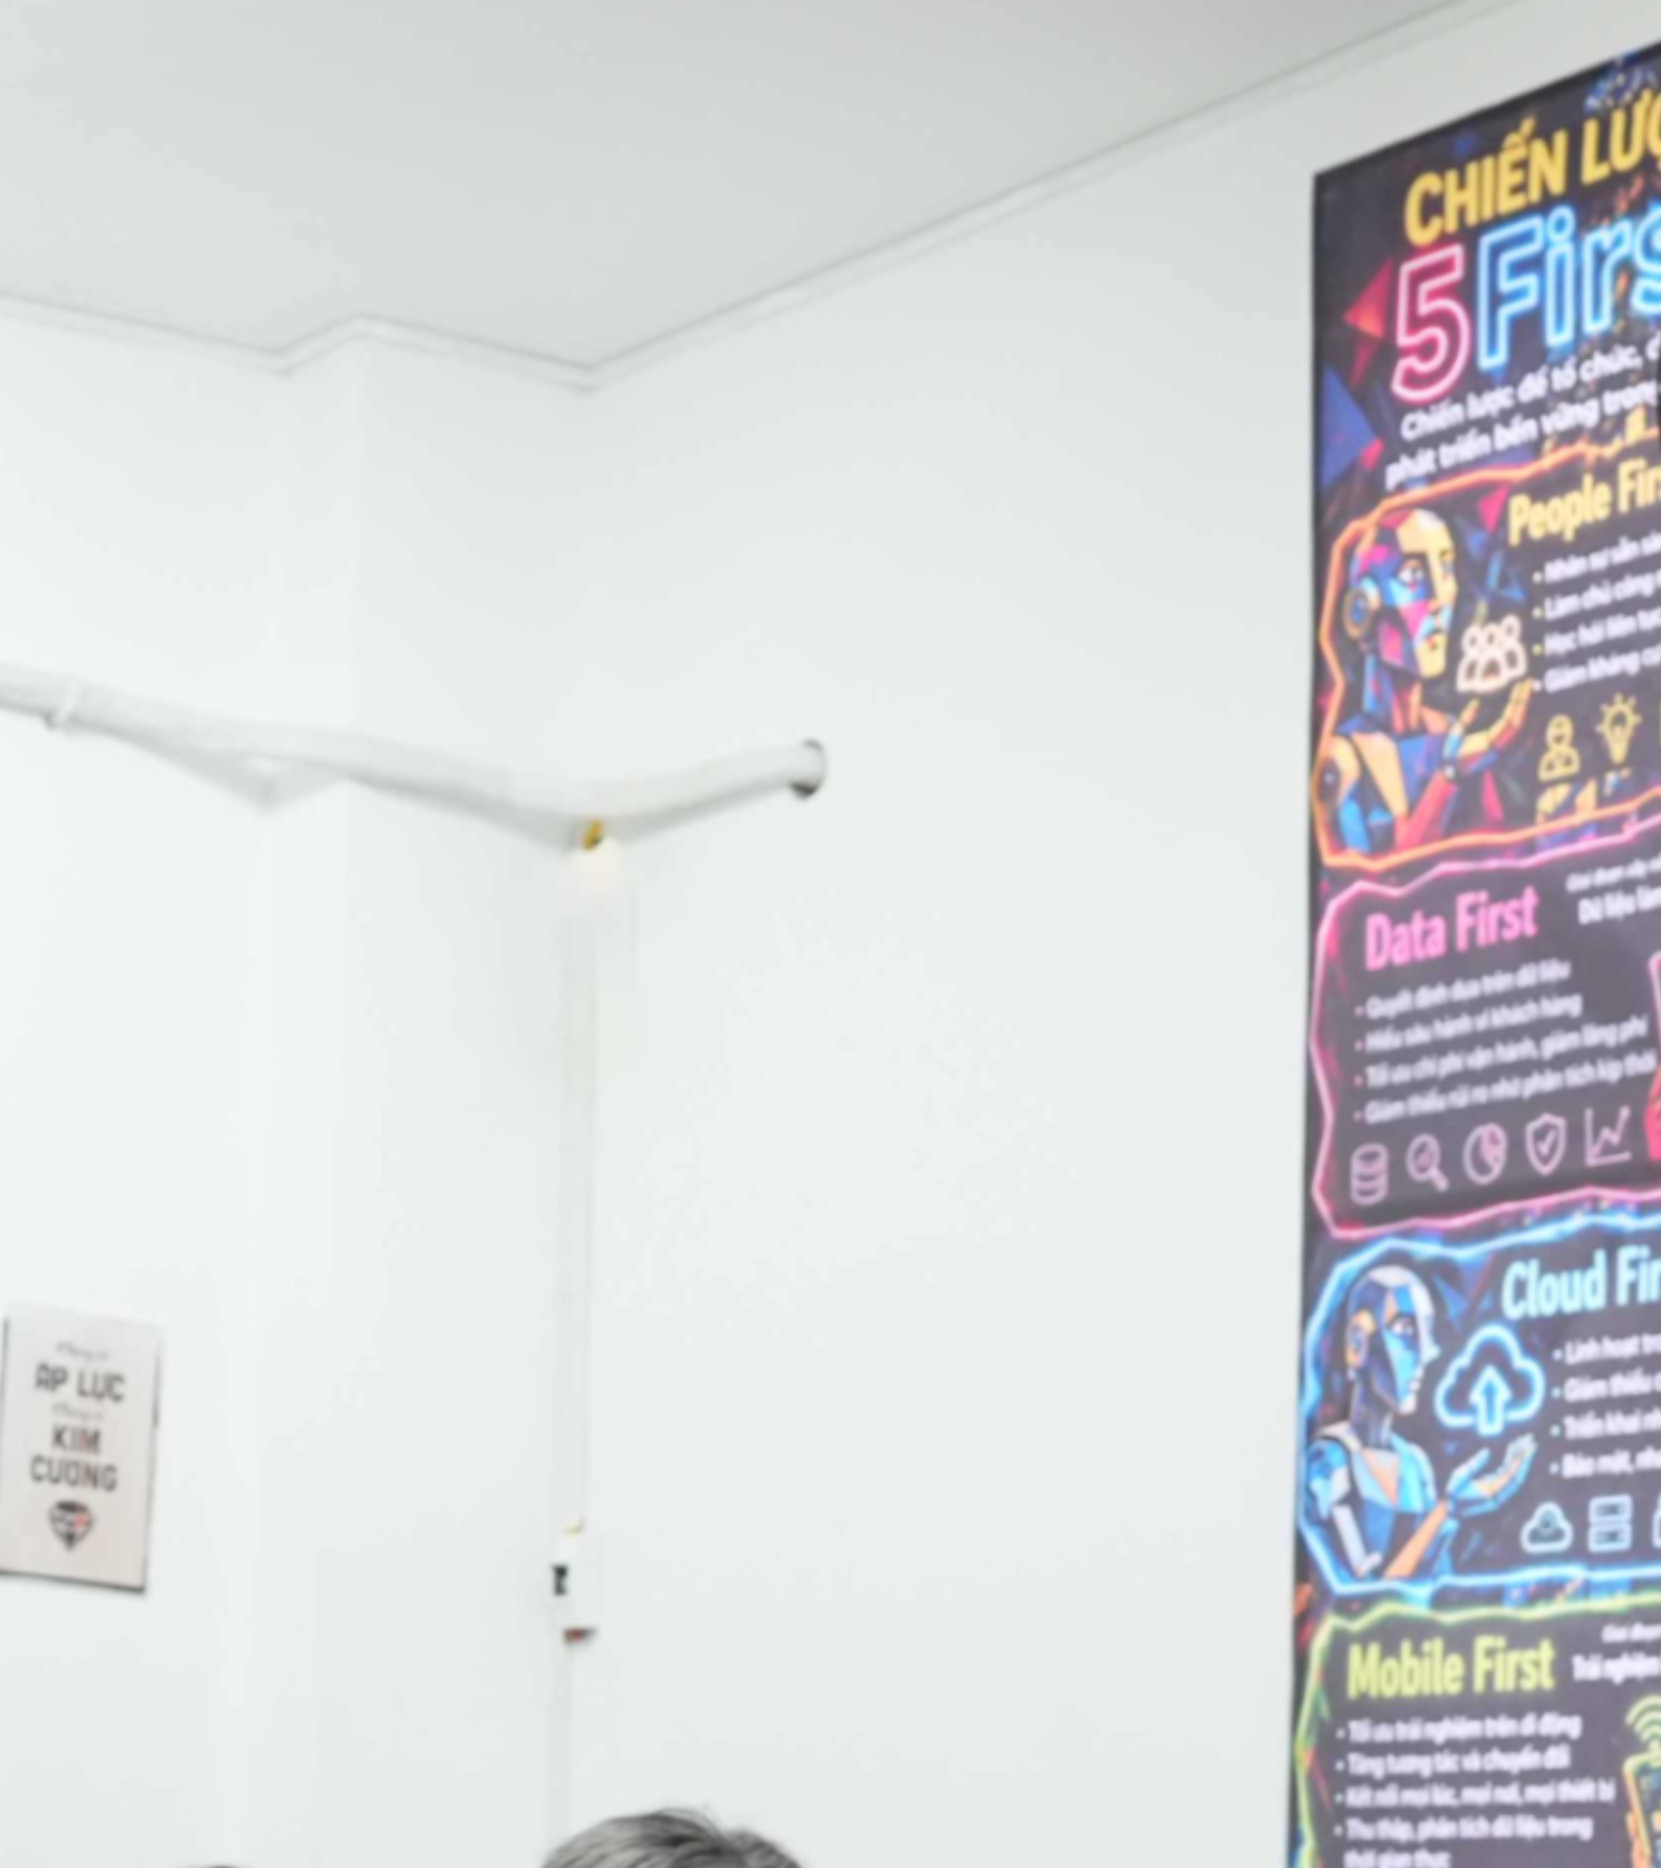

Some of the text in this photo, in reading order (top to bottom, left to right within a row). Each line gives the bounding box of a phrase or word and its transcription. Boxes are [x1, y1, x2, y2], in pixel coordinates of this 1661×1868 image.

[1404, 117, 1569, 247] CHIẾN
[1508, 470, 1612, 548] People
[1365, 885, 1540, 972] Data First
[1501, 1253, 1606, 1320] Cloud
[52, 1424, 101, 1455] KIM
[1346, 1634, 1555, 1700] Mobile First
